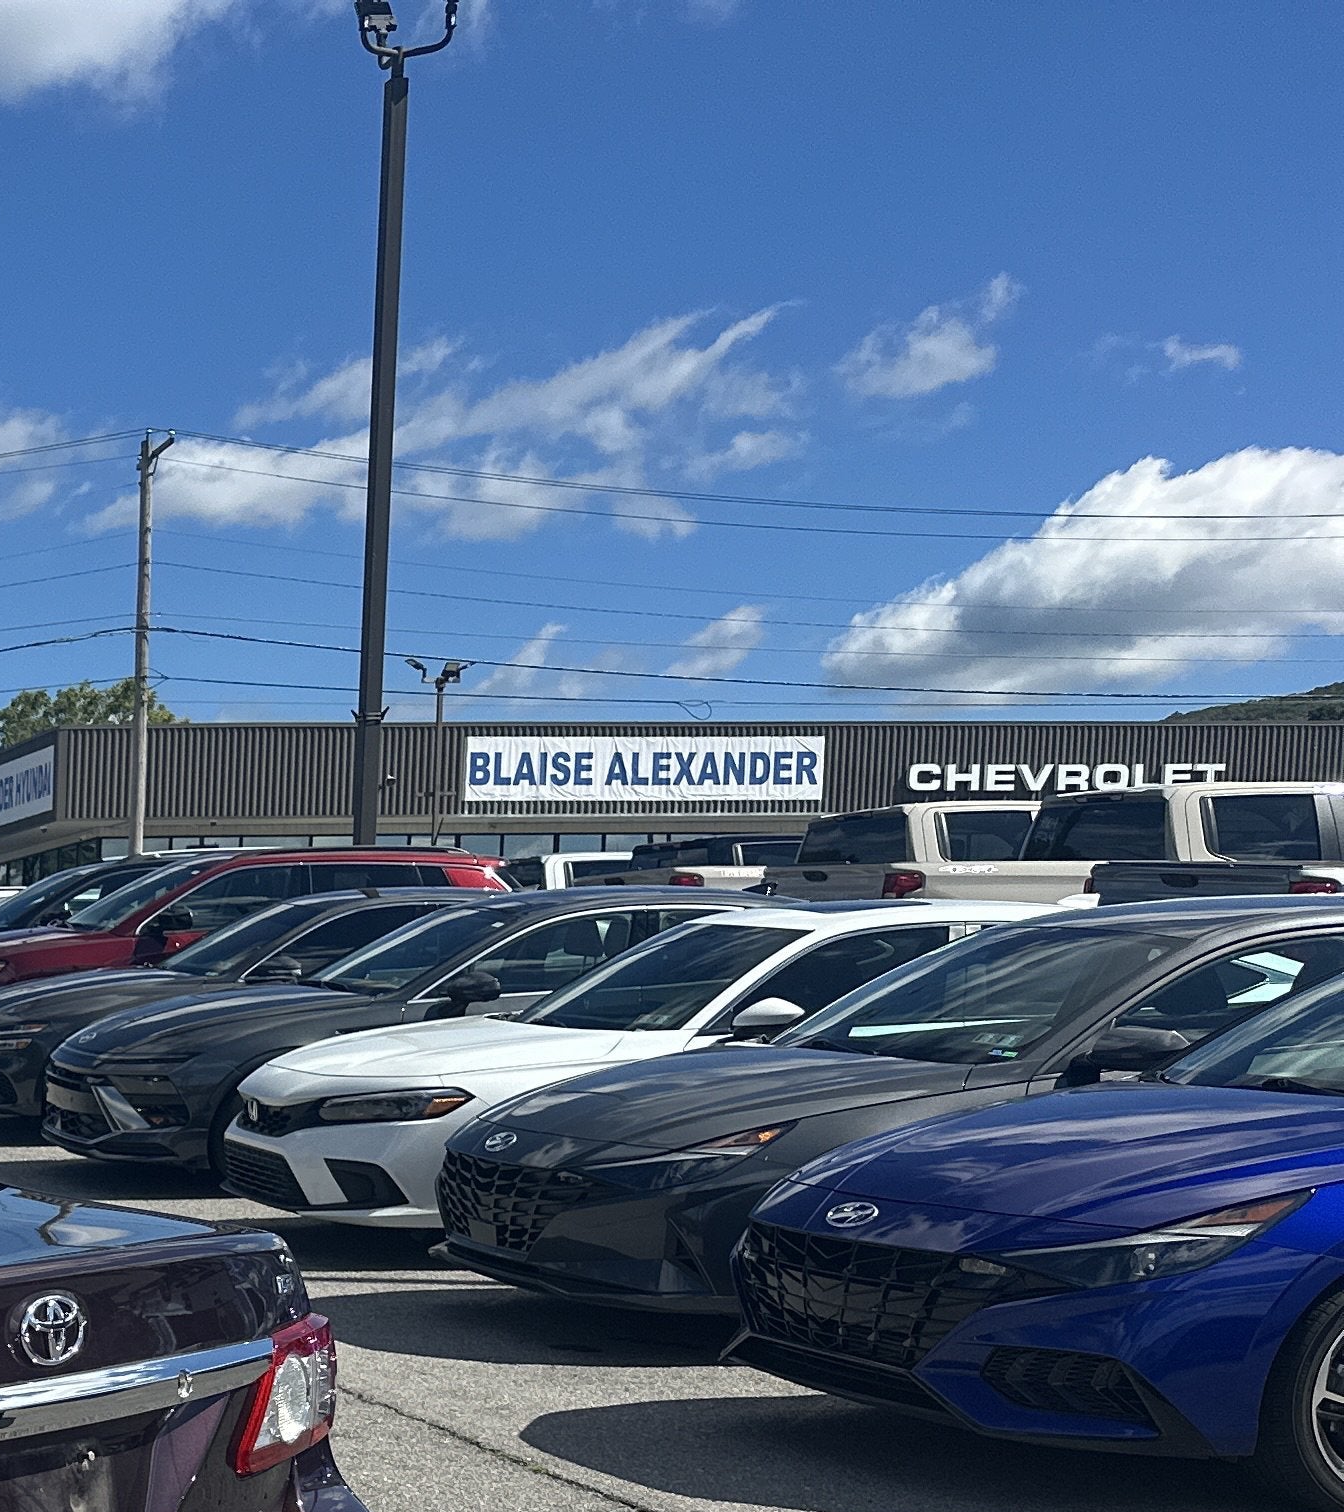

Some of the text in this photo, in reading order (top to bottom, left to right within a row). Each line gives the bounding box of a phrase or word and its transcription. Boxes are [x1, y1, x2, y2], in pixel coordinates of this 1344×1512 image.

[15, 761, 52, 807] HYUNDAI
[468, 751, 818, 786] BLAISE ALEXANDER
[907, 763, 1226, 792] CHEVROLET
